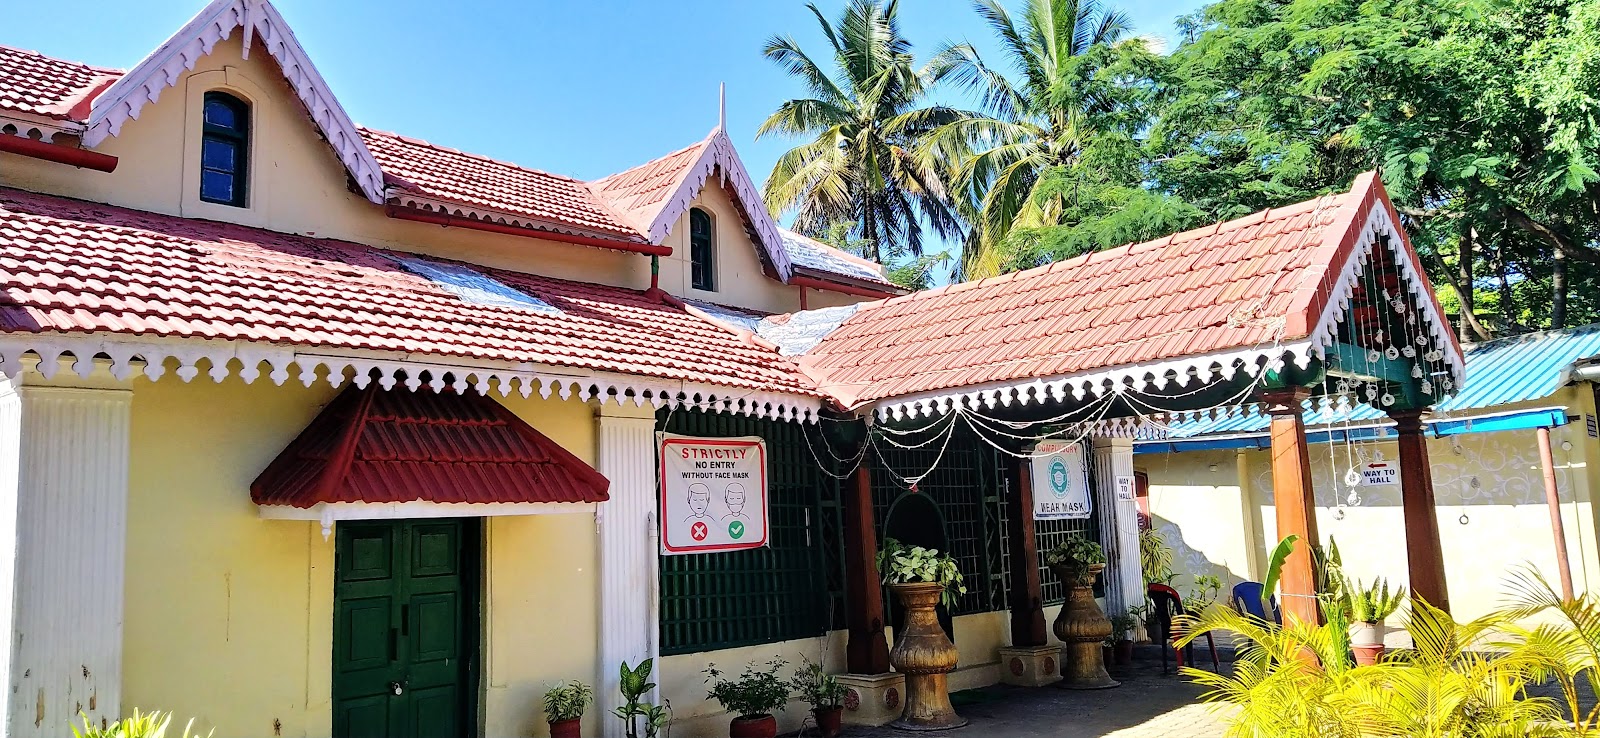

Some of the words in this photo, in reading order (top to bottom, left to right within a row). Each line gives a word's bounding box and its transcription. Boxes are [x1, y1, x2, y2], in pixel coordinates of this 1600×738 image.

[682, 448, 747, 459] STRICTLY
[696, 461, 707, 469] NO
[710, 461, 735, 469] ENTRY
[1041, 502, 1060, 513] WEAR
[1062, 502, 1084, 512] MASK
